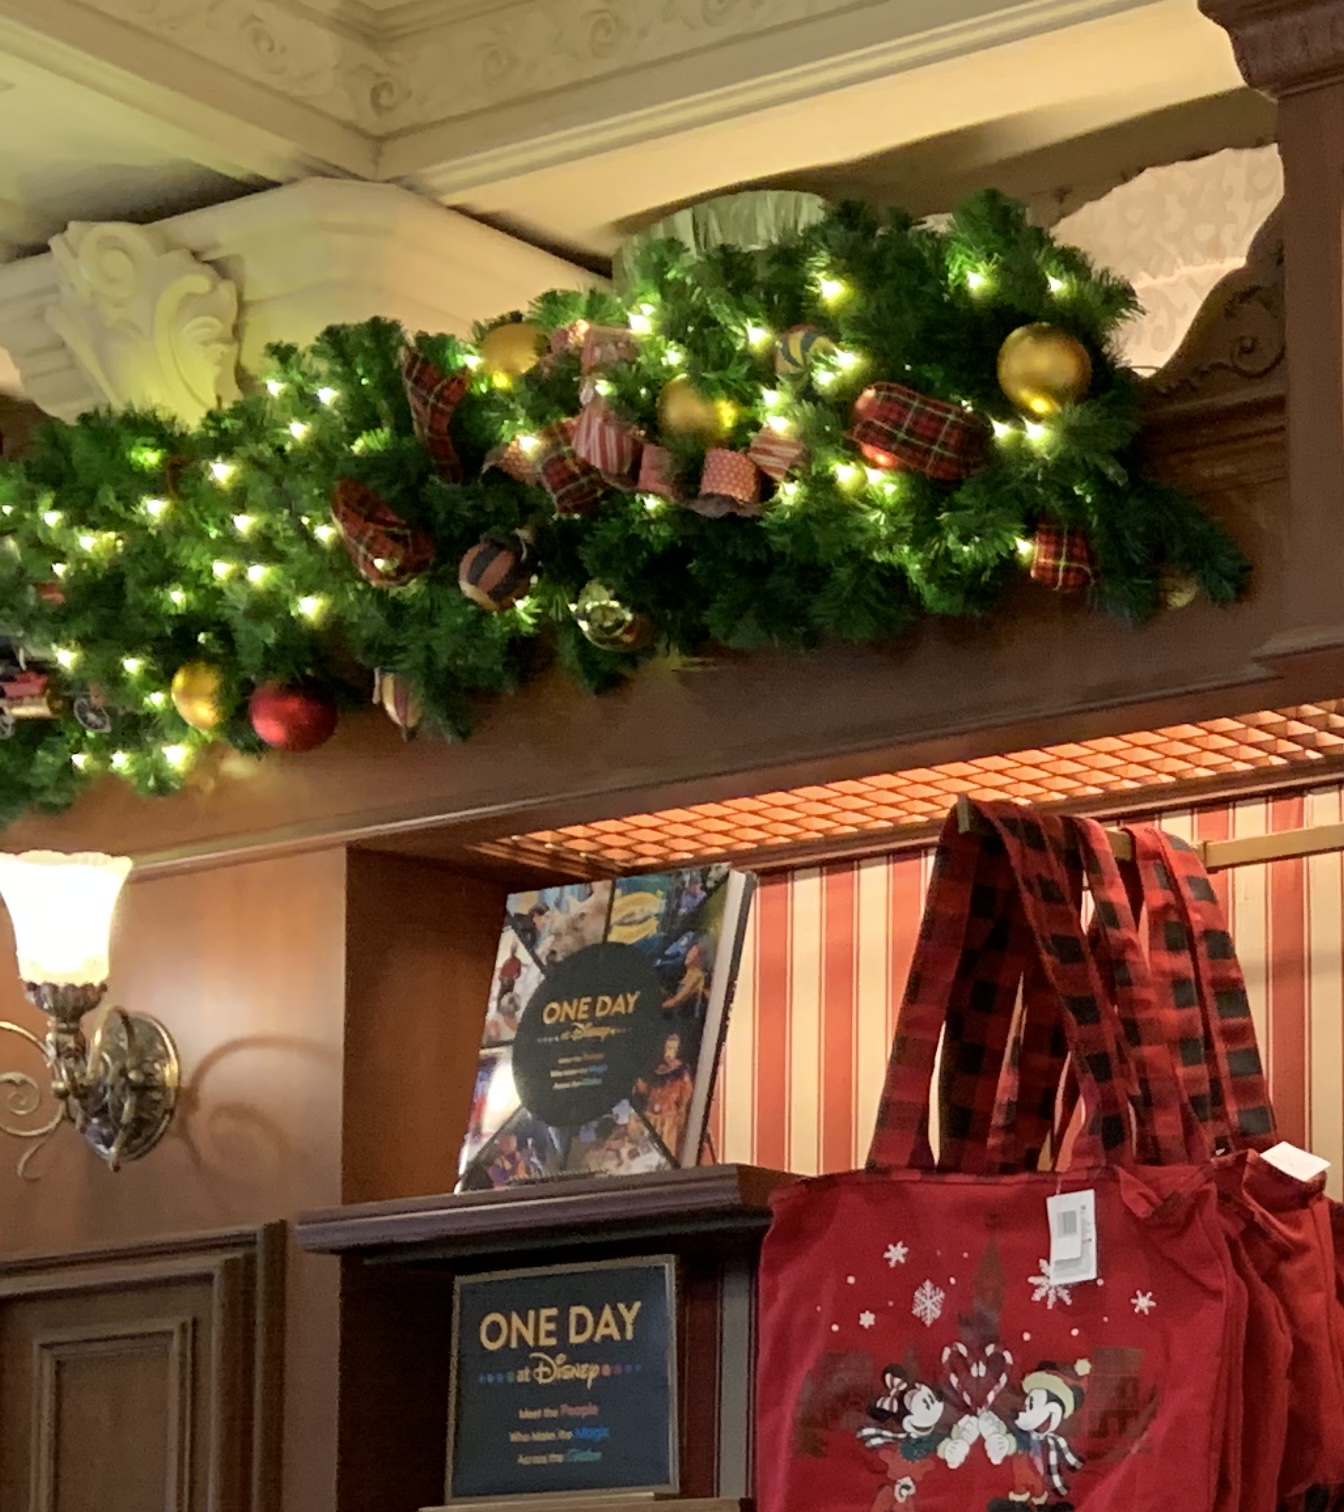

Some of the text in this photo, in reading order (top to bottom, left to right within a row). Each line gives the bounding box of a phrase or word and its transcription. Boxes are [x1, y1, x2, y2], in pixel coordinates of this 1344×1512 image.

[542, 990, 641, 1024] ONE DAY
[479, 1300, 642, 1350] ONE DAY
[517, 1352, 600, 1390] at Disney
